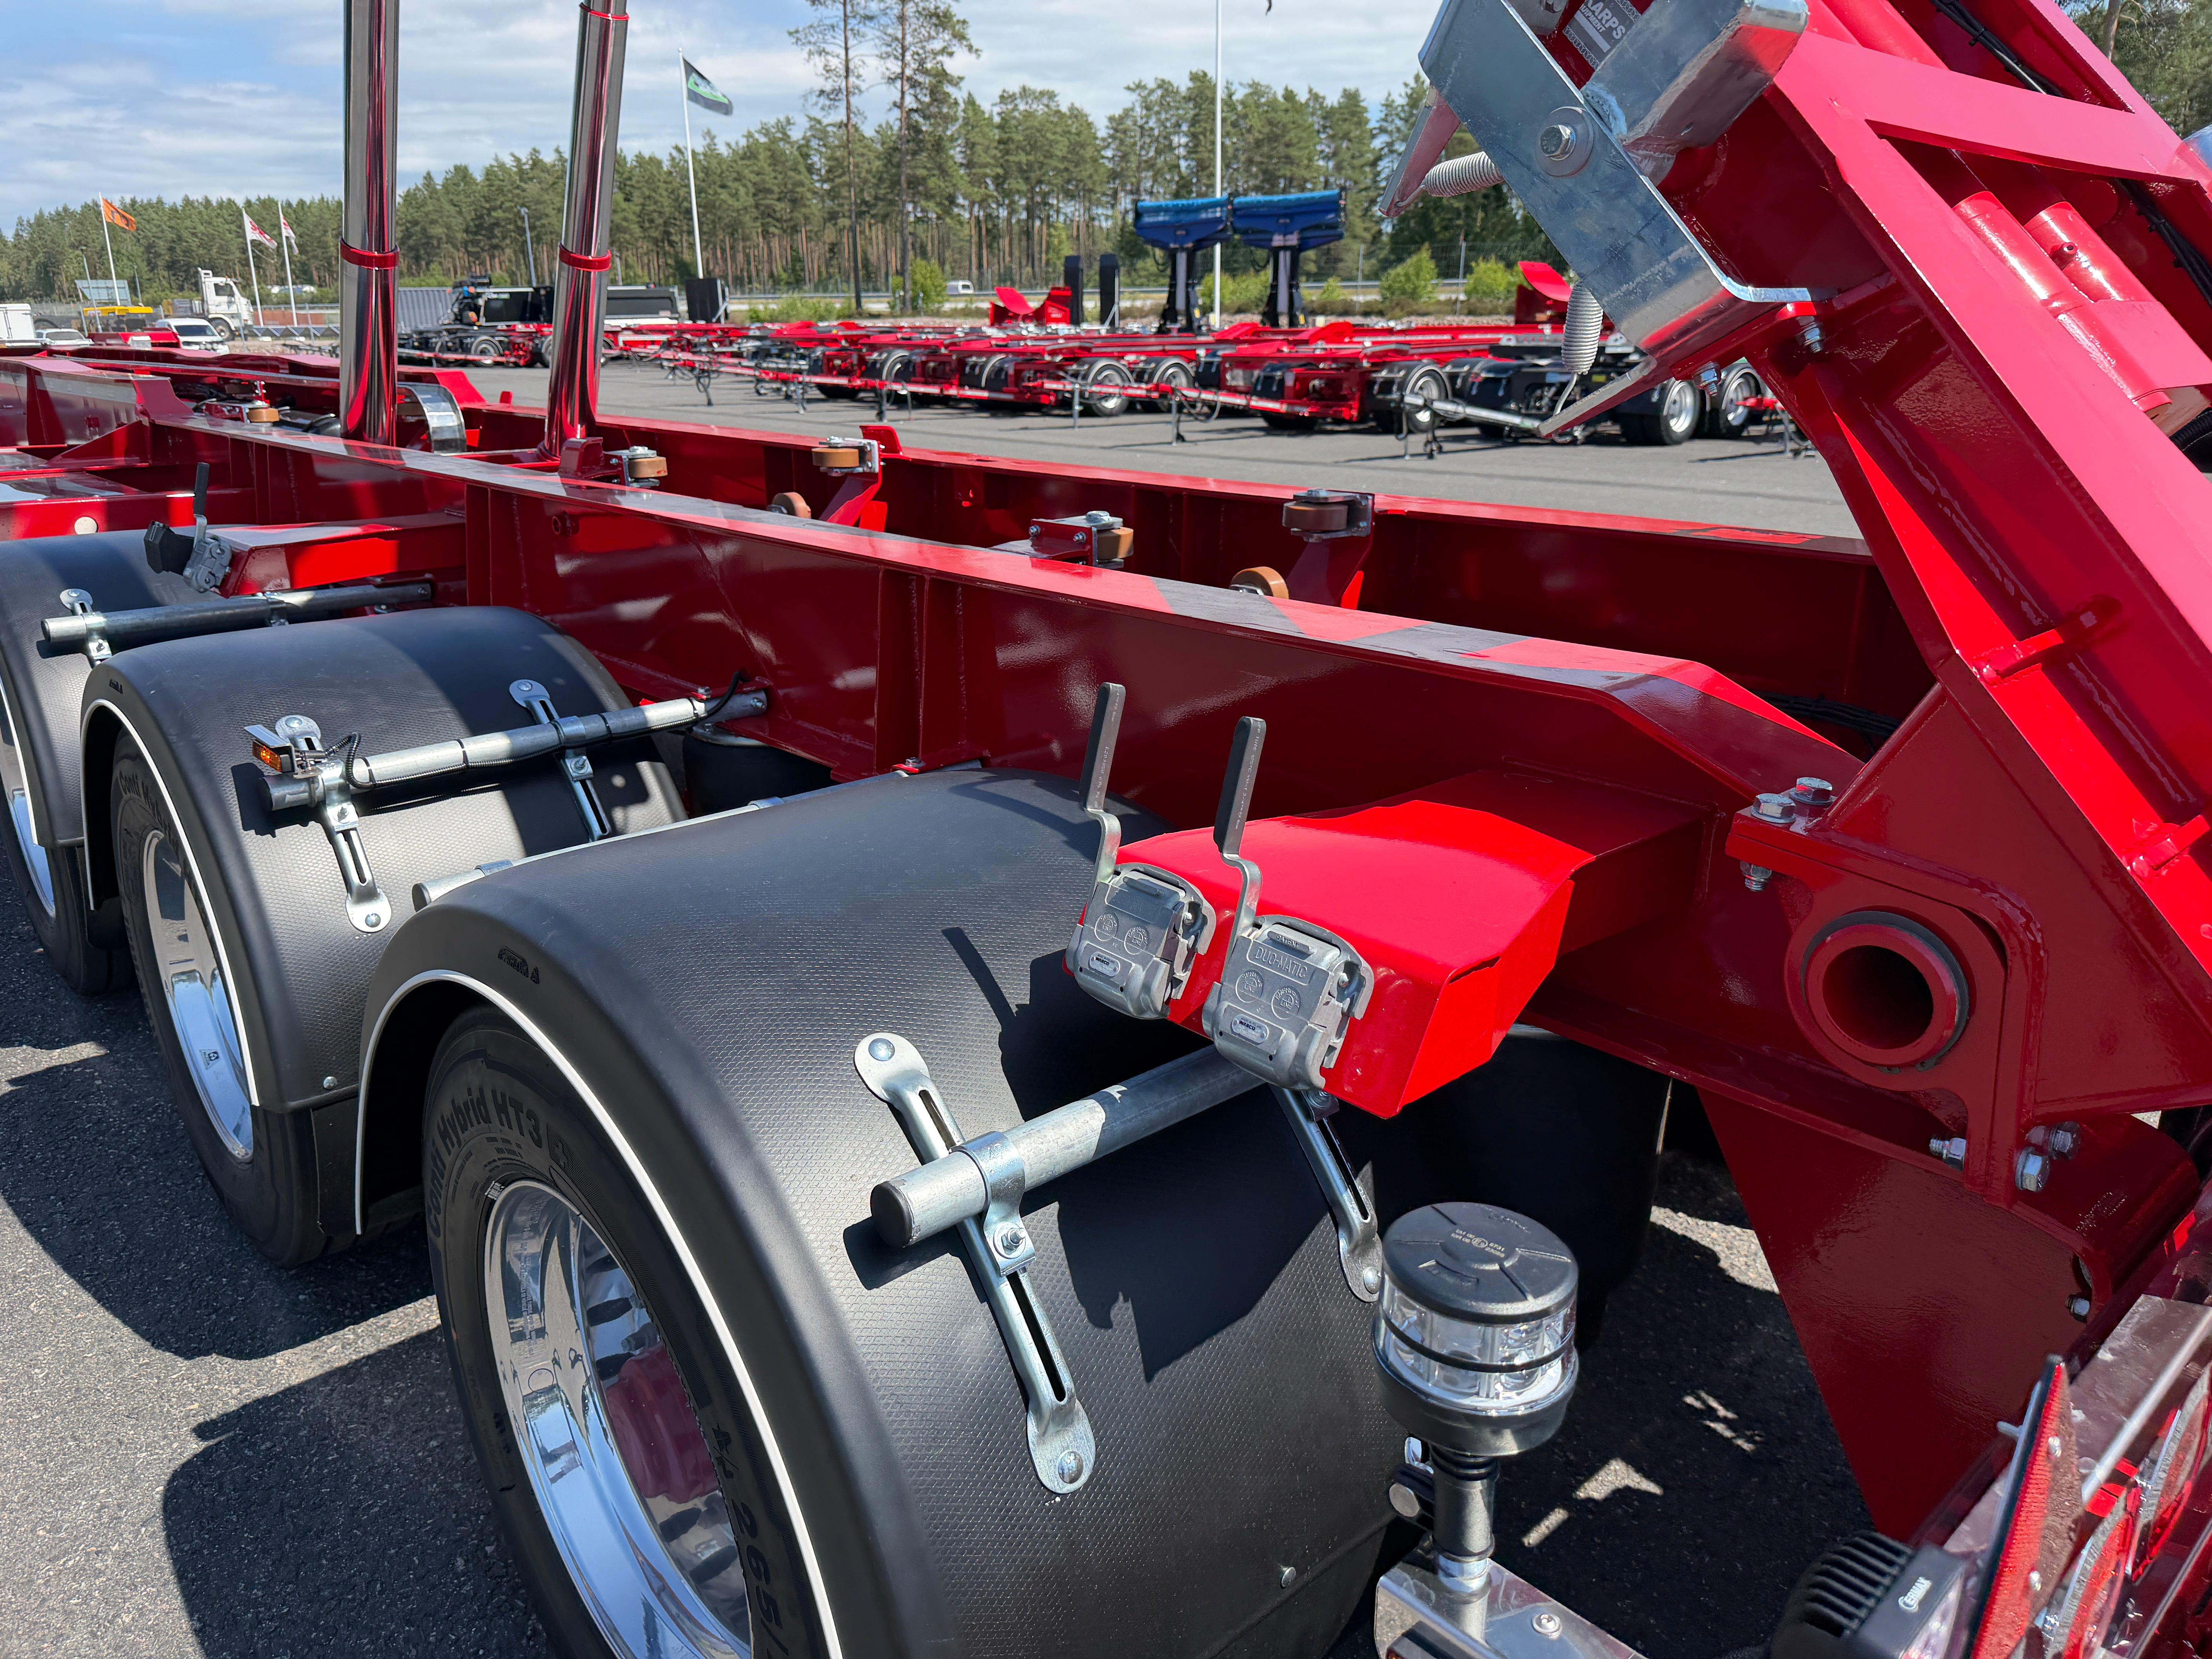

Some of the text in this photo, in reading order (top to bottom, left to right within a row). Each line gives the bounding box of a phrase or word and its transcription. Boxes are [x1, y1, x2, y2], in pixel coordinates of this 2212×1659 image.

[1580, 4, 1606, 33] UIPMENT
[1255, 947, 1307, 978] DUO-MATIC
[1239, 1020, 1255, 1030] WABCO
[436, 1087, 492, 1157] Hybrid
[427, 1136, 447, 1238] Conti
[731, 1498, 789, 1659] 265/
